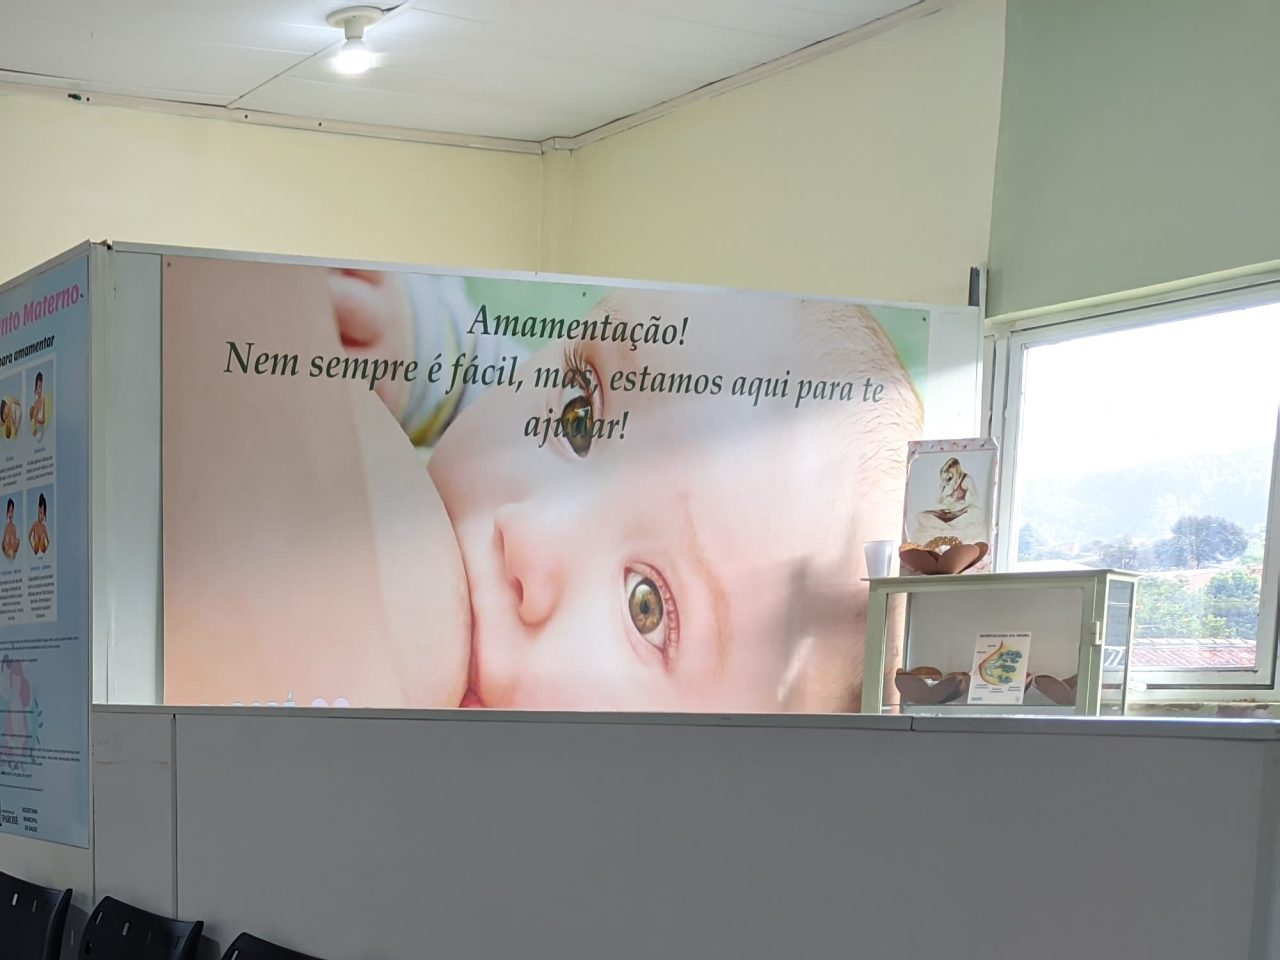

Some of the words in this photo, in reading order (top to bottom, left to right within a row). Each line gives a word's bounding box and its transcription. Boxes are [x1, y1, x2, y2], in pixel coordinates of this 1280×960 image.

[23, 284, 80, 327] Materno
[466, 303, 690, 351] Amamentação!
[13, 335, 55, 363] amamentar
[223, 340, 300, 377] Nem
[308, 353, 419, 391] sempre
[427, 353, 443, 383] é
[444, 352, 525, 394] fácil,
[533, 365, 600, 395] mas,
[609, 364, 723, 395] estamos
[730, 370, 791, 407] aqui
[794, 377, 854, 408] para
[861, 376, 886, 403] te
[523, 408, 630, 448] ajudar!
